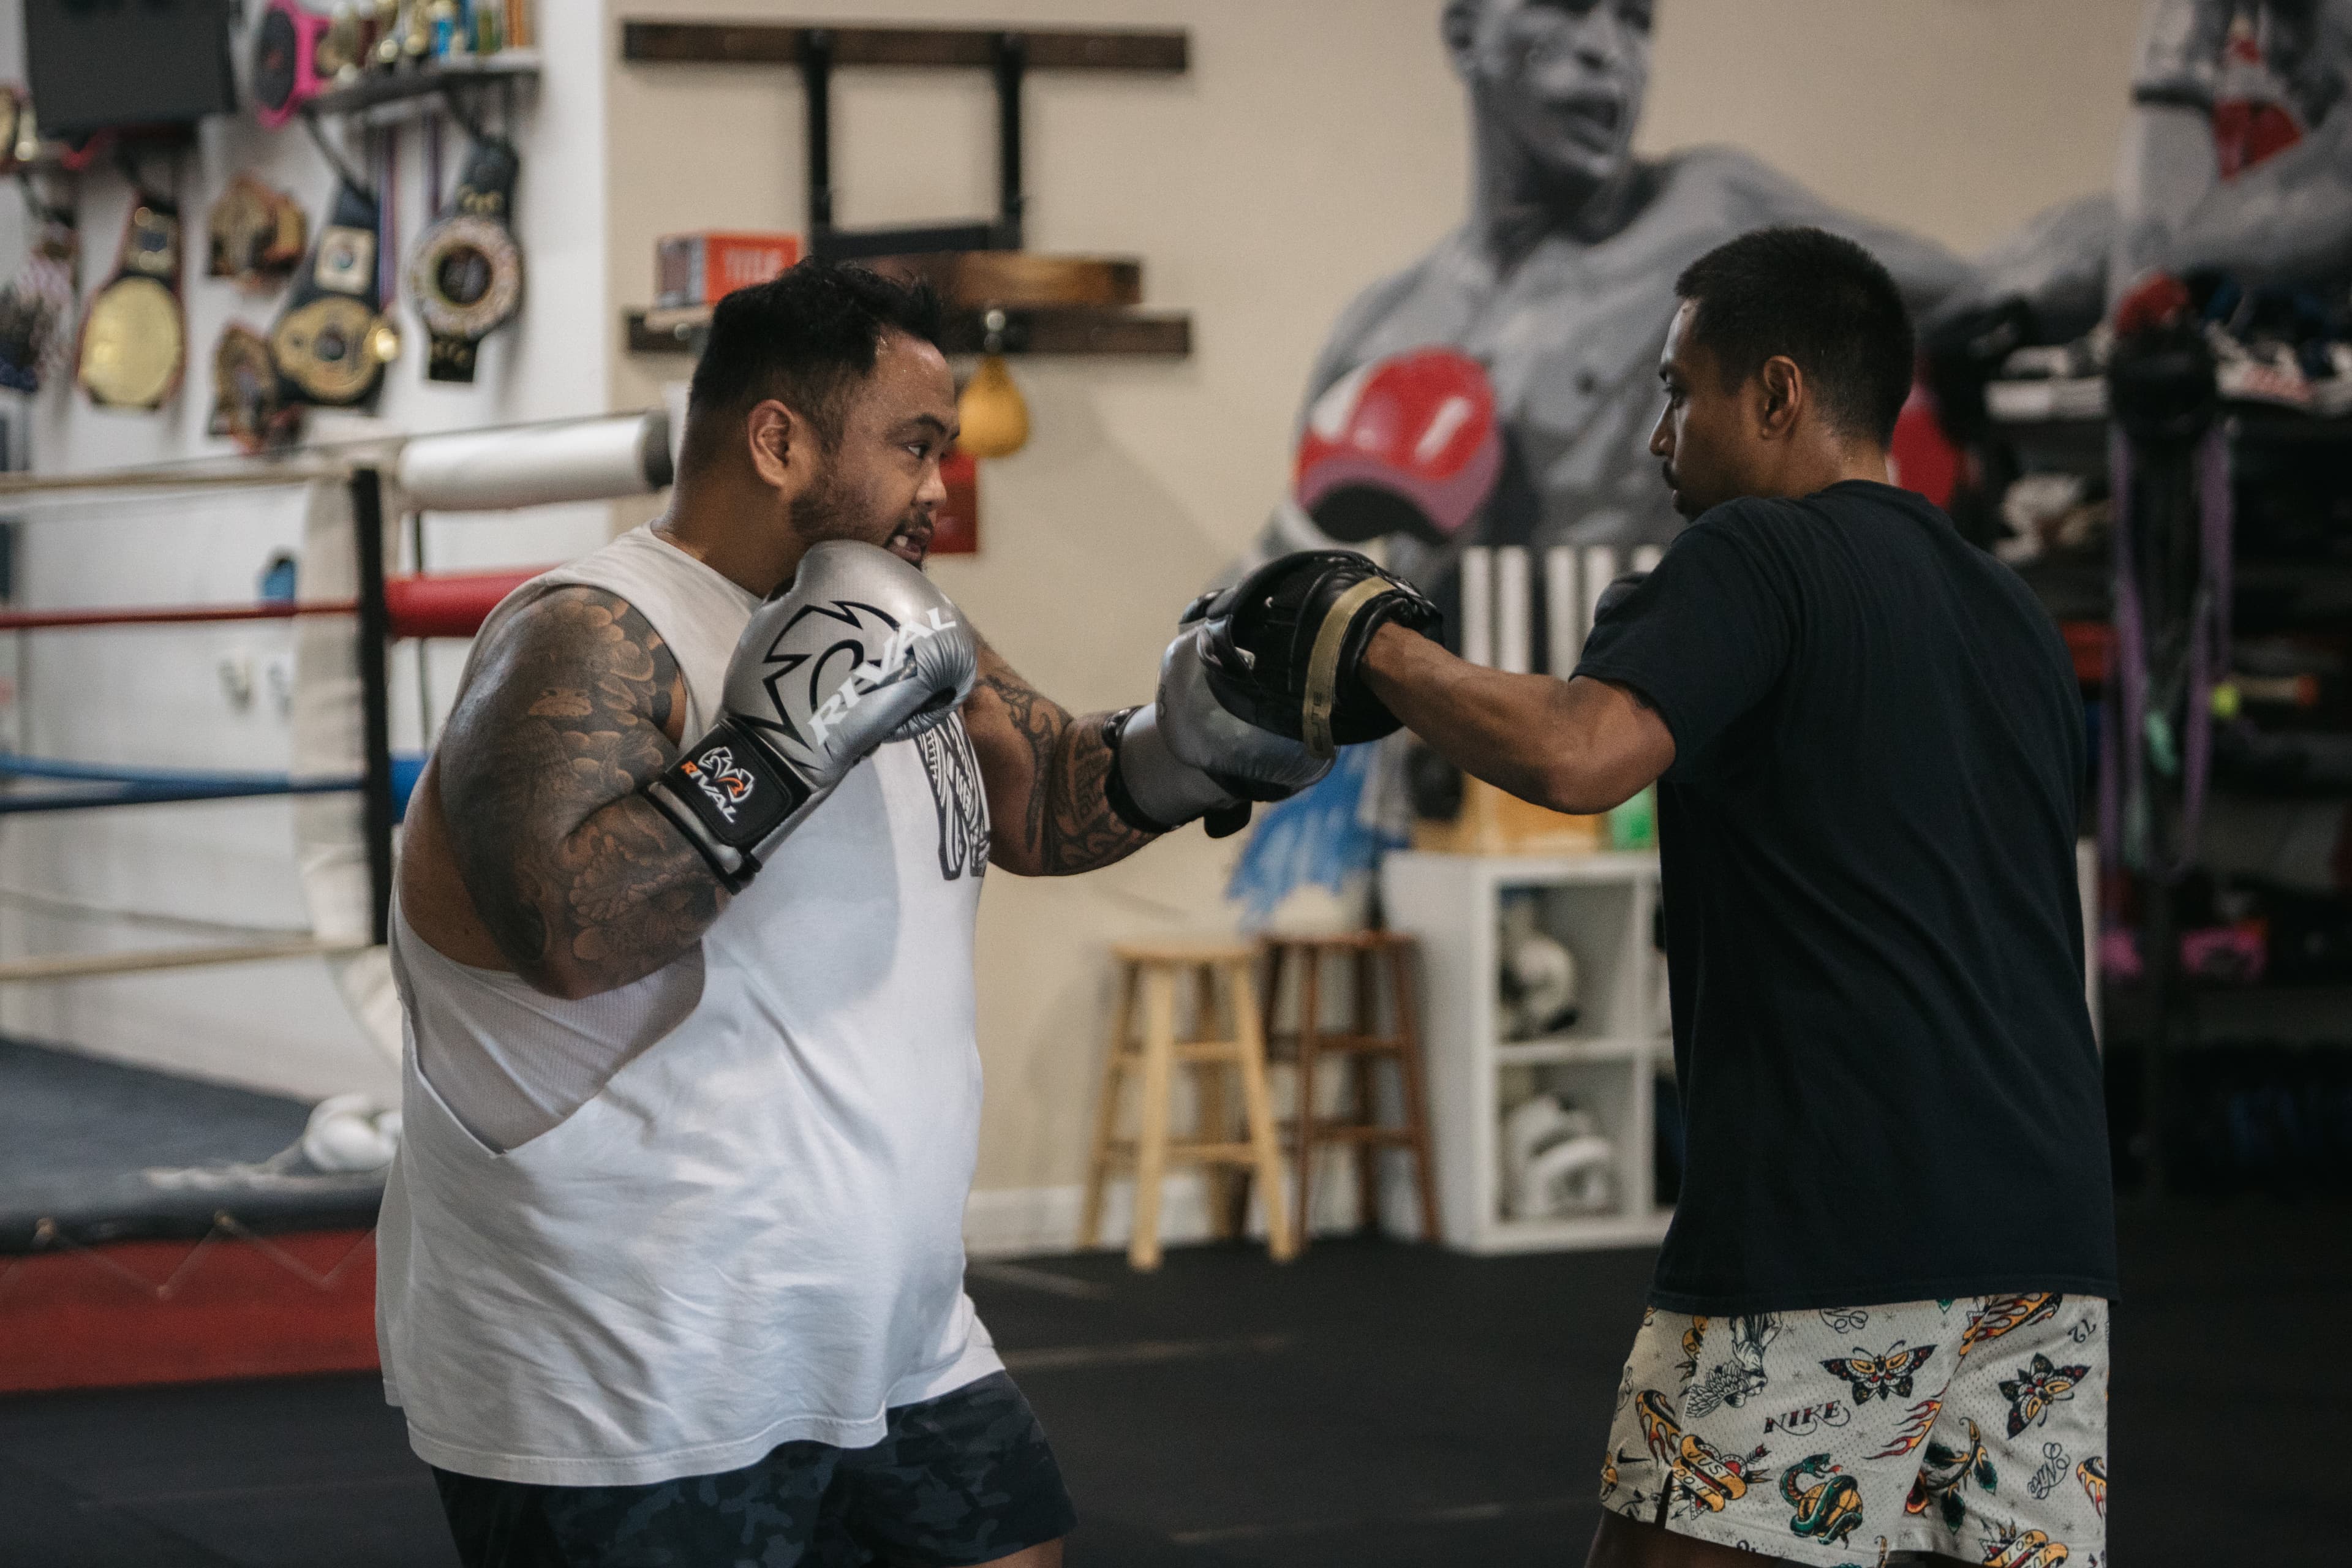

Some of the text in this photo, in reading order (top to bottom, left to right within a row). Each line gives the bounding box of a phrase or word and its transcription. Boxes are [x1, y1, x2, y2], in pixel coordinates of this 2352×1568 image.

[807, 607, 957, 746] RIVAL
[680, 760, 737, 824] RIVAL
[1763, 1398, 1851, 1436] NIKE
[1686, 1450, 1735, 1480] JUST
[1675, 1468, 1720, 1498] DO IT
[2016, 1533, 2034, 1551] DO
